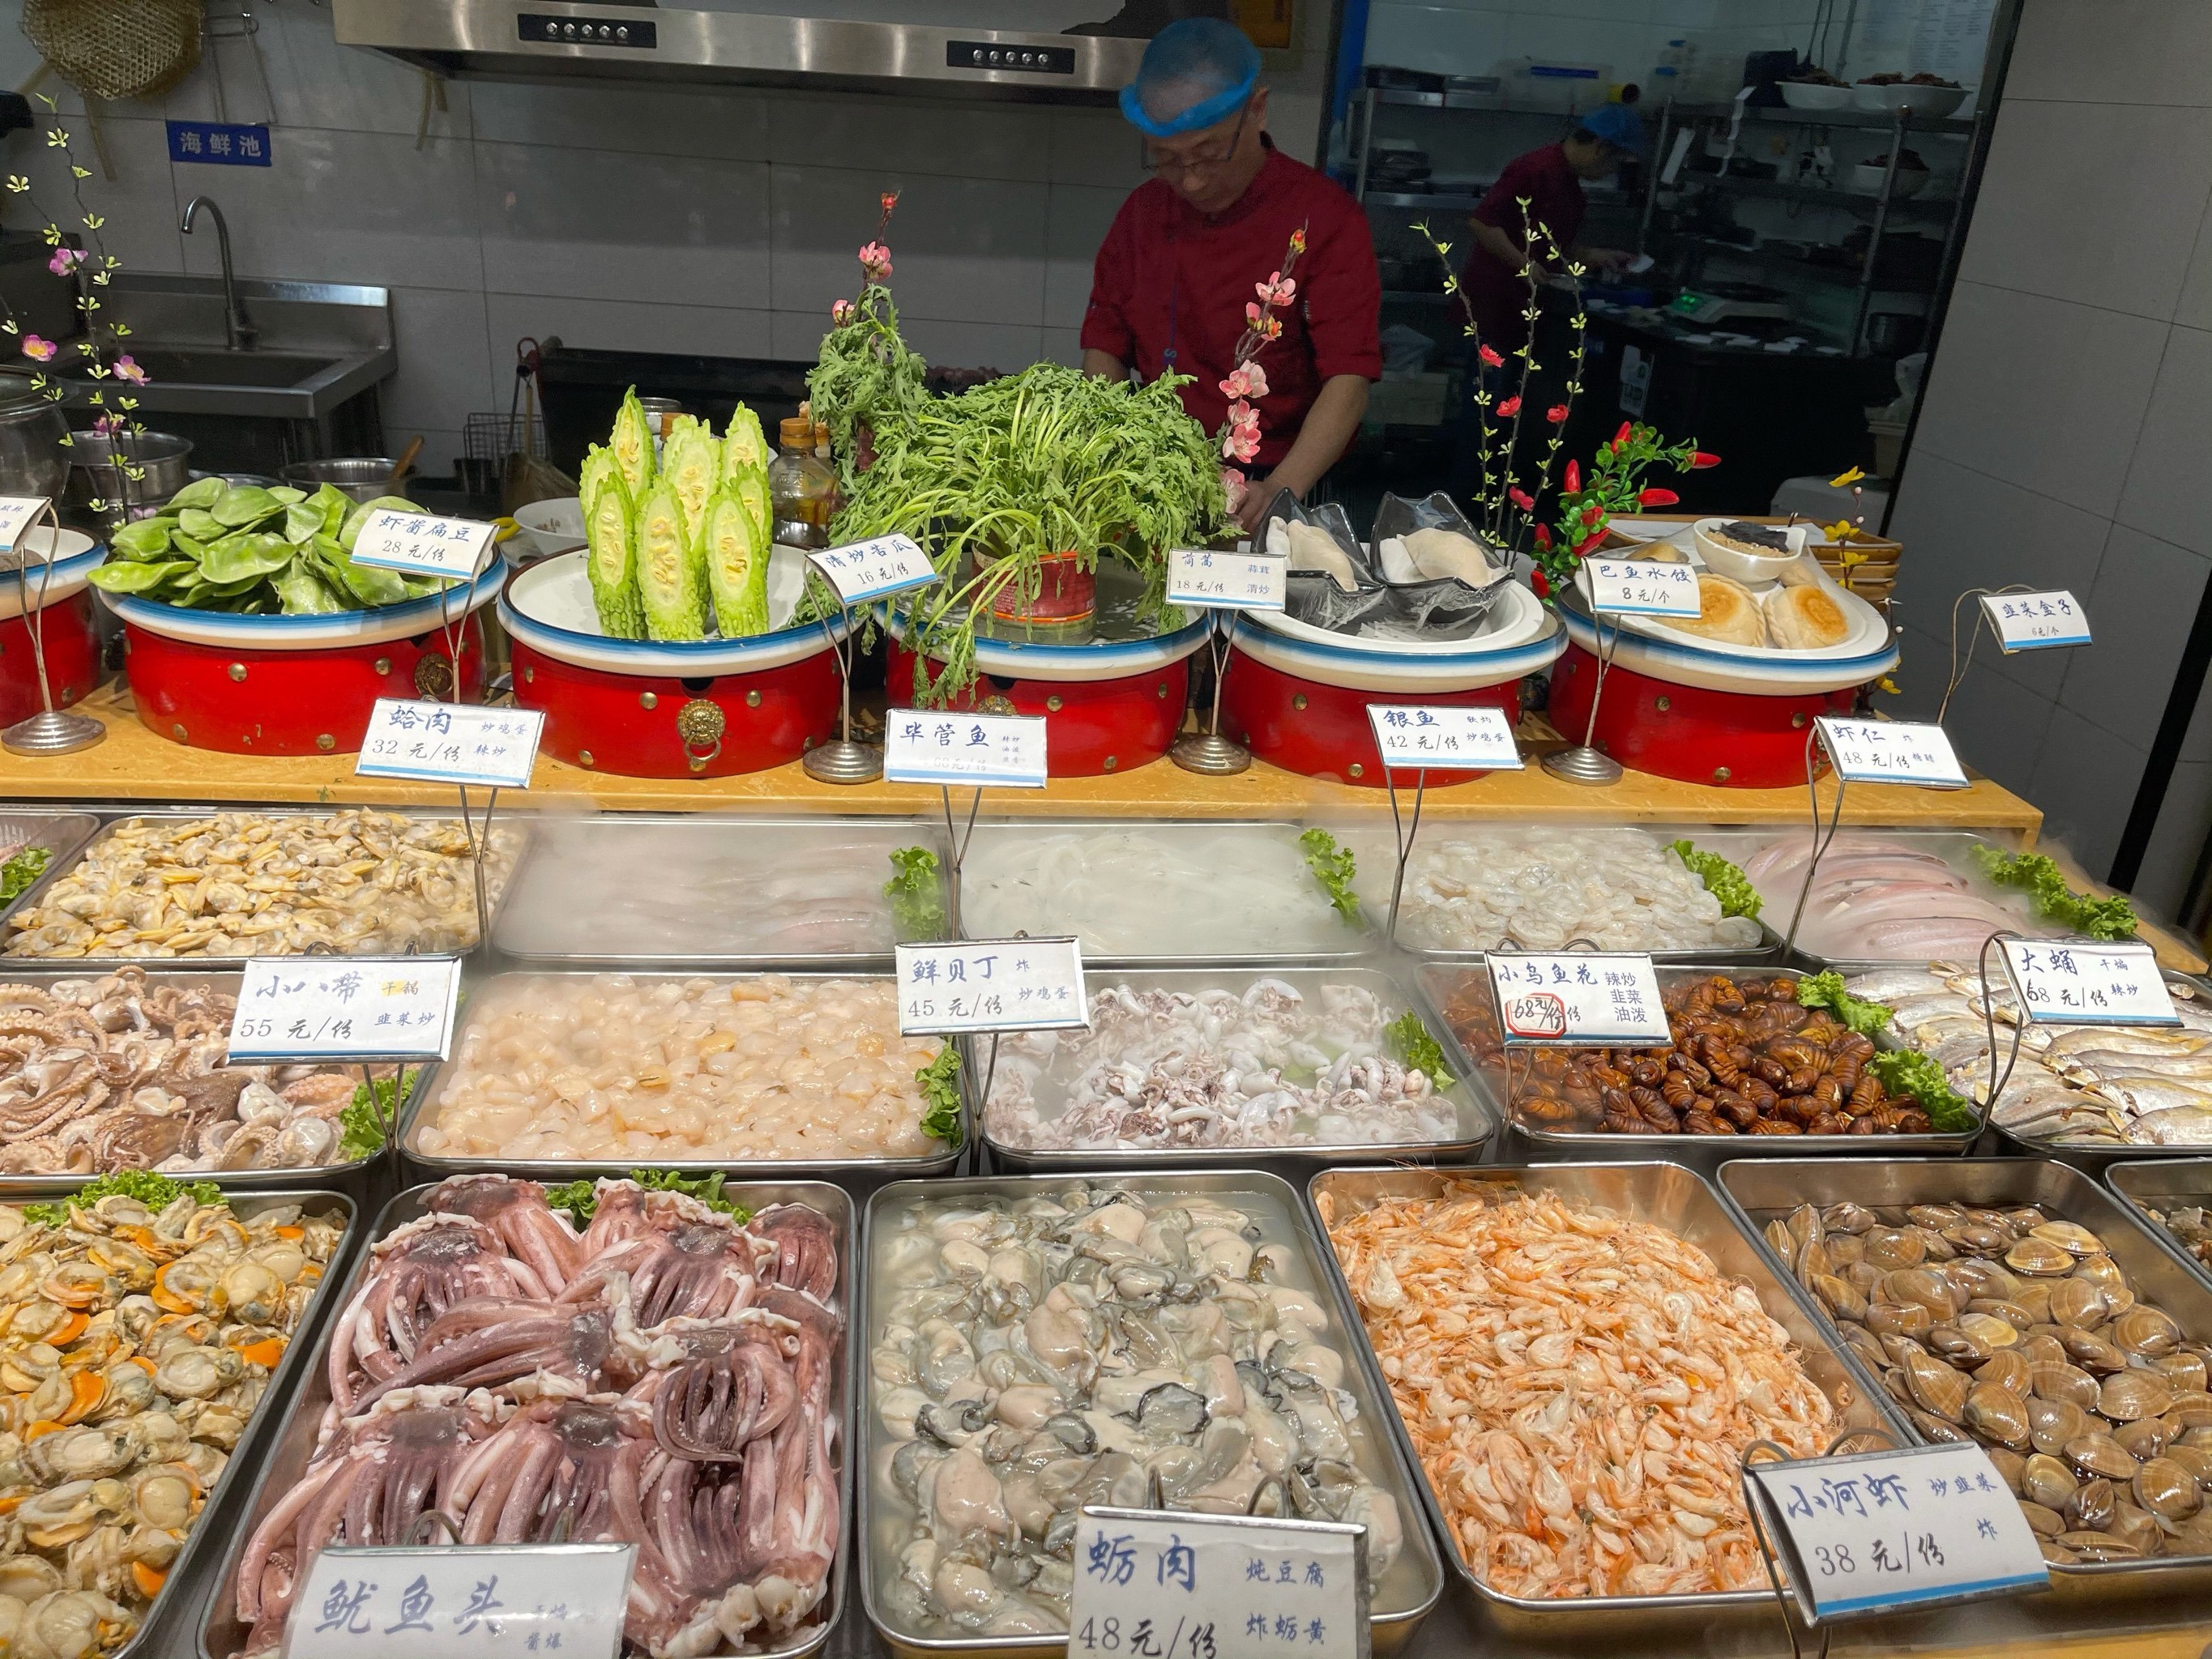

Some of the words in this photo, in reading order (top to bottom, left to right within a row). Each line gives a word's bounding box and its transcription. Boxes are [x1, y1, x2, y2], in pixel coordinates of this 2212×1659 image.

[179, 131, 262, 157] 海鲜池
[378, 515, 471, 542] 虾酱扁豆
[825, 539, 913, 568] 清炒苦瓜
[1599, 565, 1692, 583] 巴鱼水饺
[2002, 599, 2071, 618] 韭菜盒子
[389, 705, 452, 736] 蛤肉
[480, 721, 528, 736] 炒鸡蛋
[1383, 710, 1441, 728] 银鱼
[899, 721, 989, 747] 毕管鱼
[1832, 723, 1886, 744] 虾仁
[911, 955, 999, 986] 鲜贝丁
[1016, 958, 1031, 973] 炸
[2021, 948, 2078, 976] 大蛹
[1604, 972, 1637, 987] 辣炒
[1018, 985, 1070, 1001] 炒鸡蛋
[1610, 988, 1643, 1004] 韭菜
[374, 1011, 436, 1026] 韭菜炒
[1614, 1007, 1647, 1023] 油泼
[1787, 1473, 1911, 1519] 小河虾
[1930, 1472, 1998, 1498] 炒韭菜
[1977, 1517, 1998, 1541] 炸
[1087, 1530, 1197, 1593] 蛎肉
[1245, 1557, 1326, 1589] 炖豆腐
[314, 1574, 504, 1636] 鱿鱼头
[1245, 1612, 1327, 1646] 炸蛎黄
